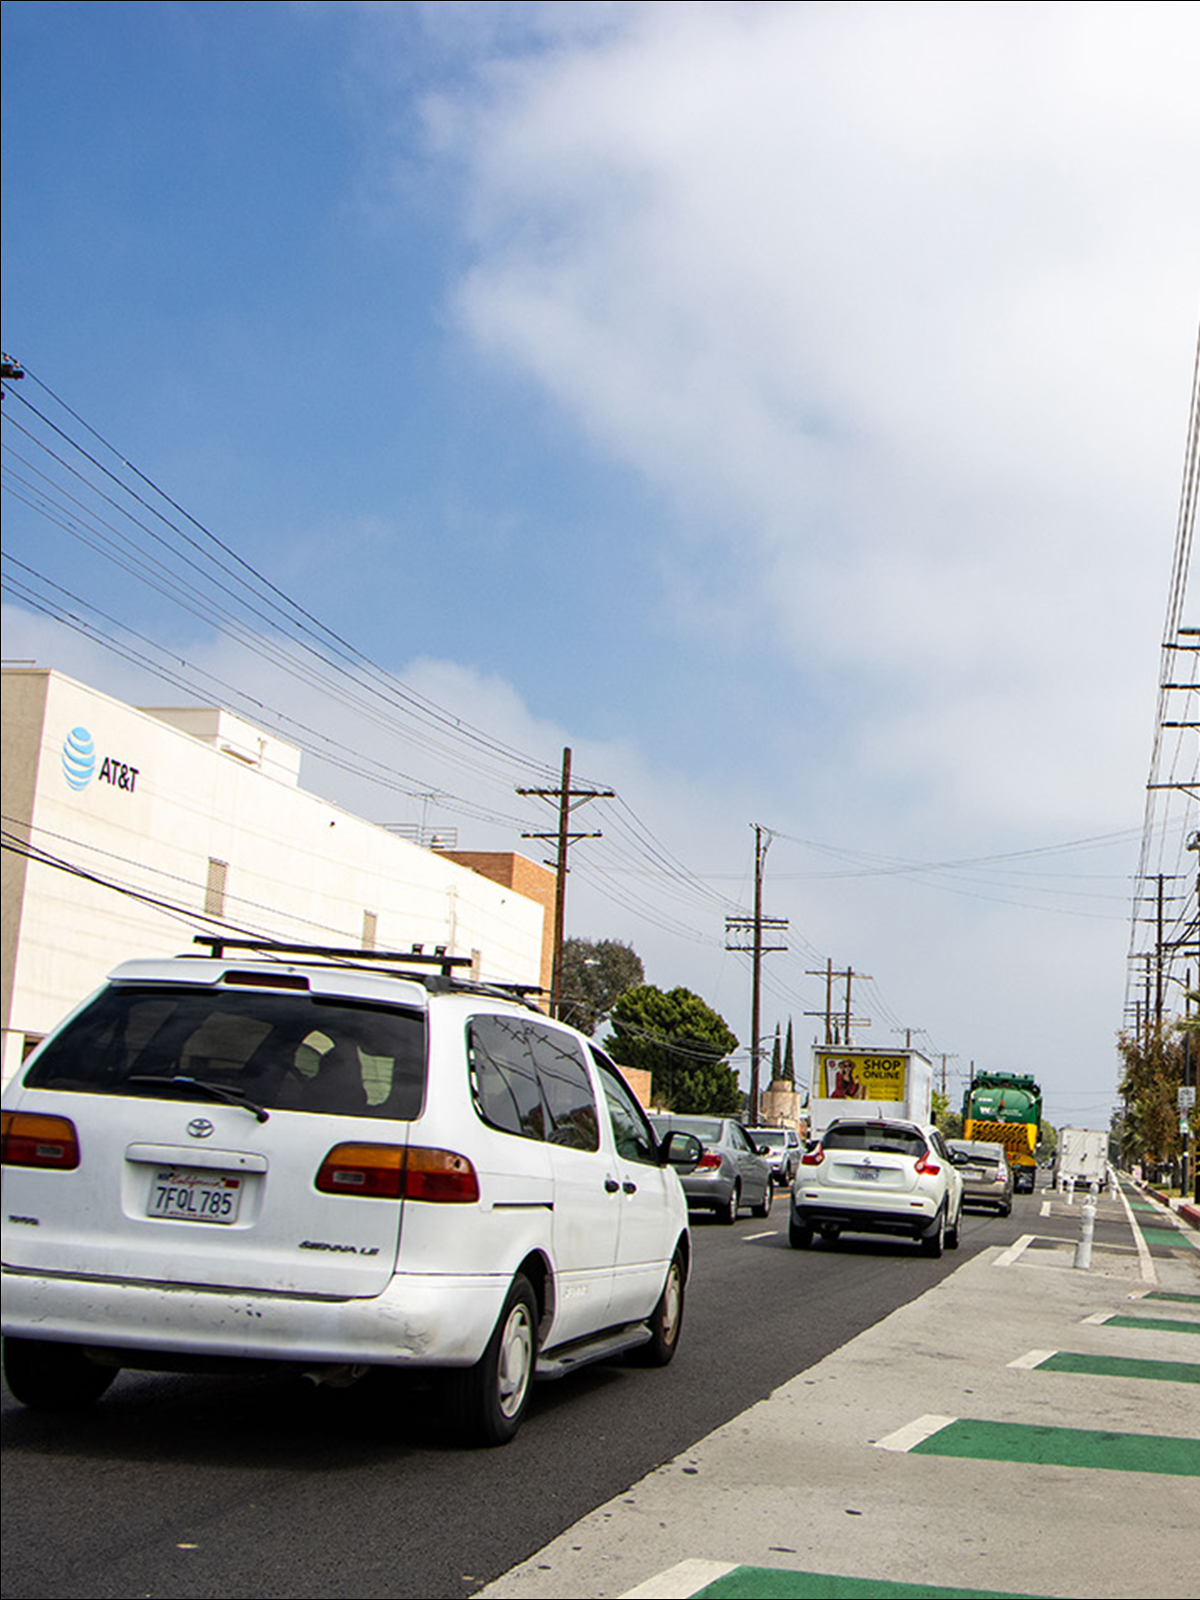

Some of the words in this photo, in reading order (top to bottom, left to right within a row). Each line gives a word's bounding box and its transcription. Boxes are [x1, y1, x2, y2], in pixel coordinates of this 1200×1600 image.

[98, 756, 140, 793] AT&T
[863, 1060, 901, 1071] SHOP
[863, 1071, 900, 1080] ONLINE
[155, 1186, 234, 1216] 7FQL785
